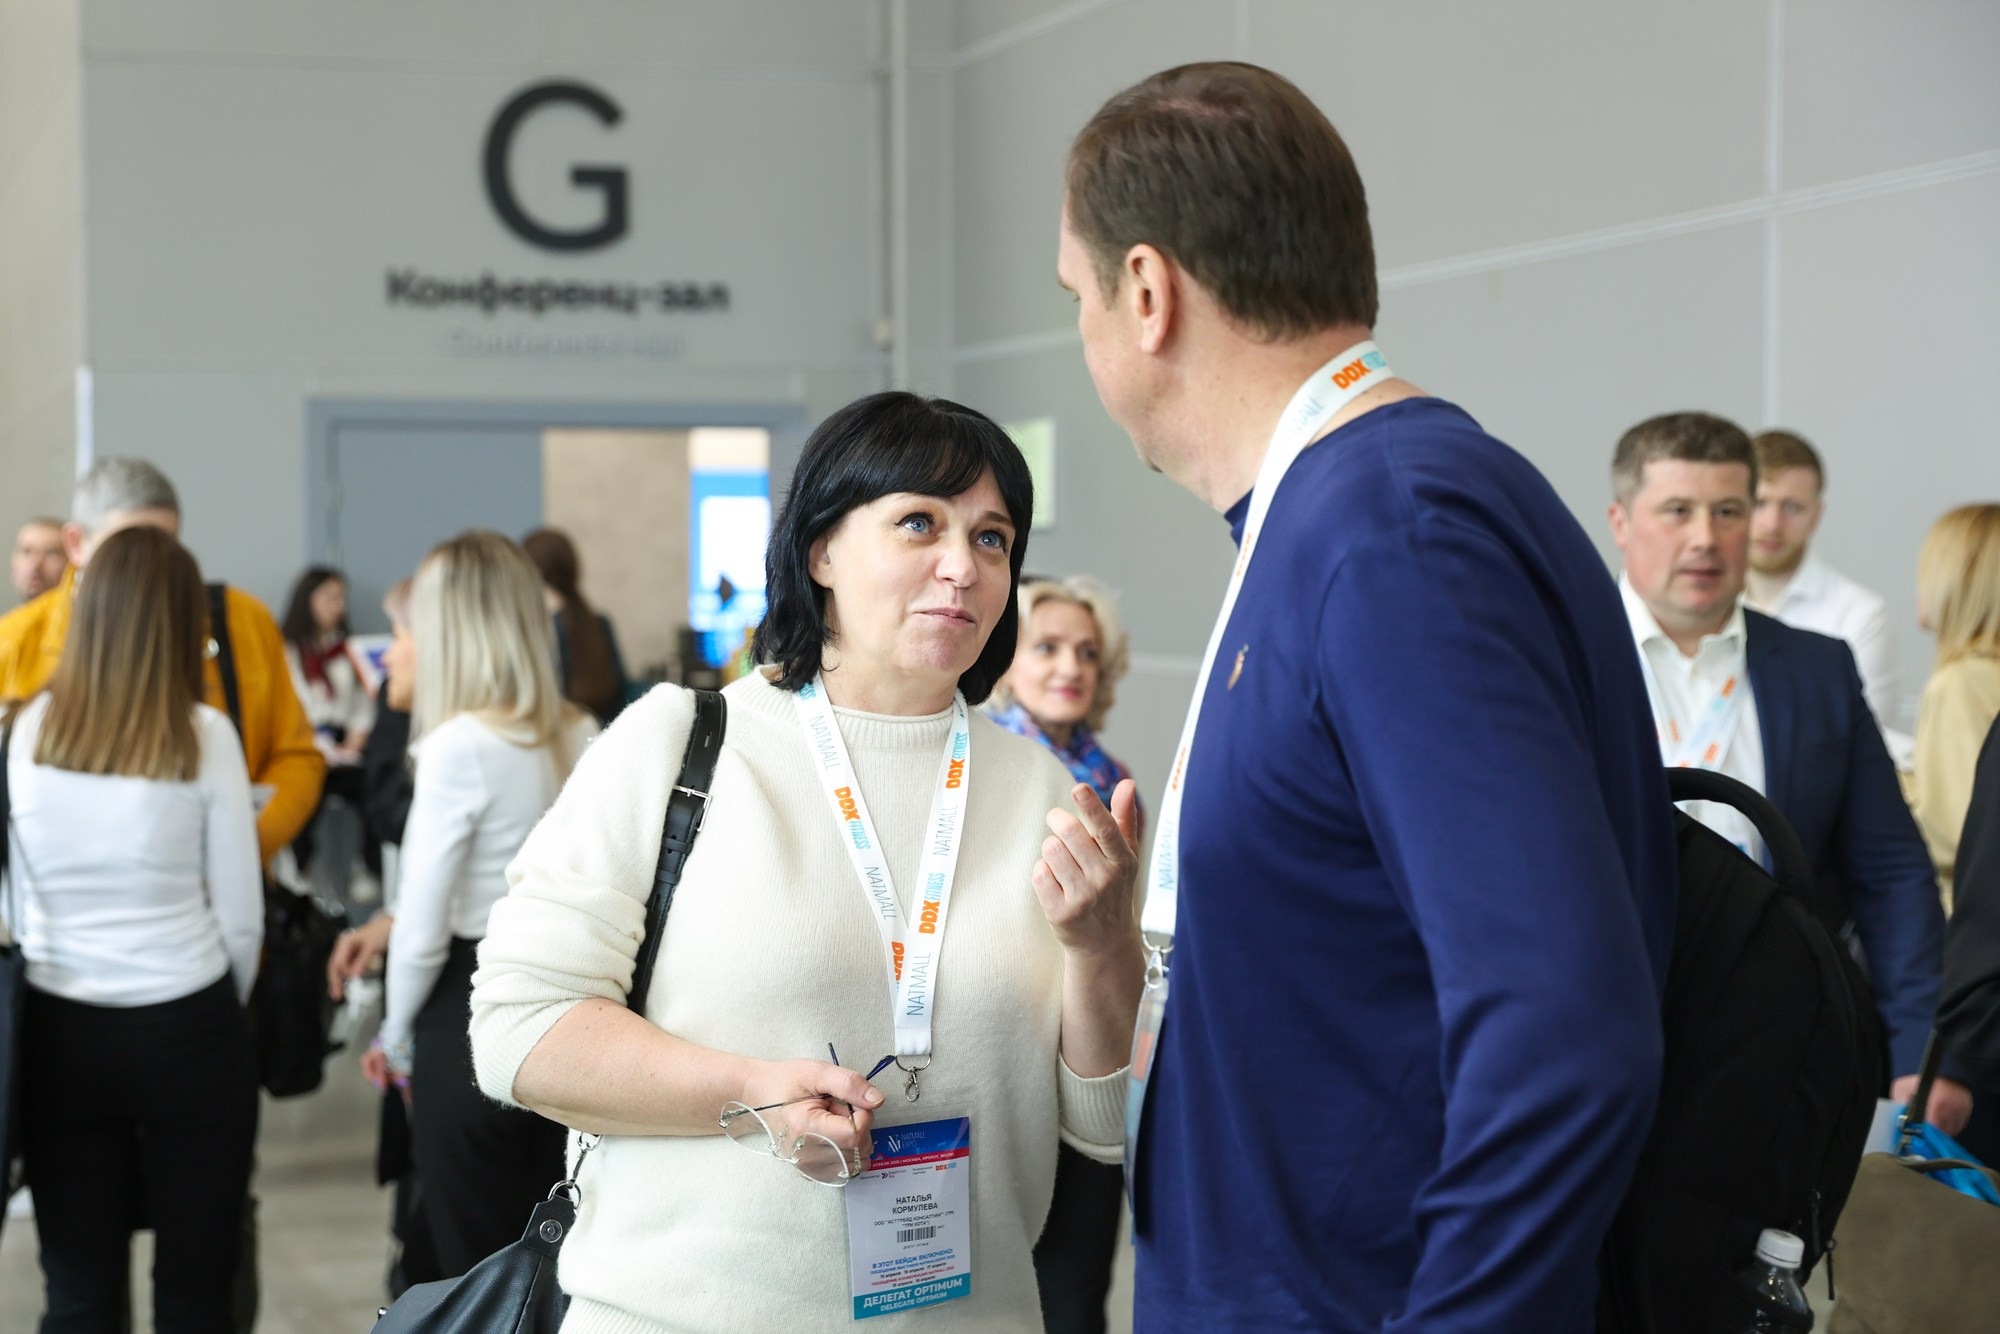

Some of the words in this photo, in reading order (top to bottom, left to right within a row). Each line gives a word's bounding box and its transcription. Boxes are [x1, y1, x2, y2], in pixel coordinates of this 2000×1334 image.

[482, 77, 631, 253] G
[386, 266, 730, 318] Конференц-зал
[809, 714, 841, 771] NATMALL
[932, 804, 957, 857] NATMALL
[864, 866, 897, 921] NATMALL
[906, 952, 931, 1016] NATMALL
[892, 1202, 938, 1215] КОРМУЛЕВА
[896, 1193, 932, 1205] НАТАЛЬЯ
[878, 1260, 894, 1269] ЭТОТ
[863, 1289, 912, 1309] ДЕЛЕГАТ
[914, 1277, 963, 1296] OPTIMUM
[880, 1299, 915, 1312] DELEGATE
[915, 1291, 948, 1303] OPTIMUM
